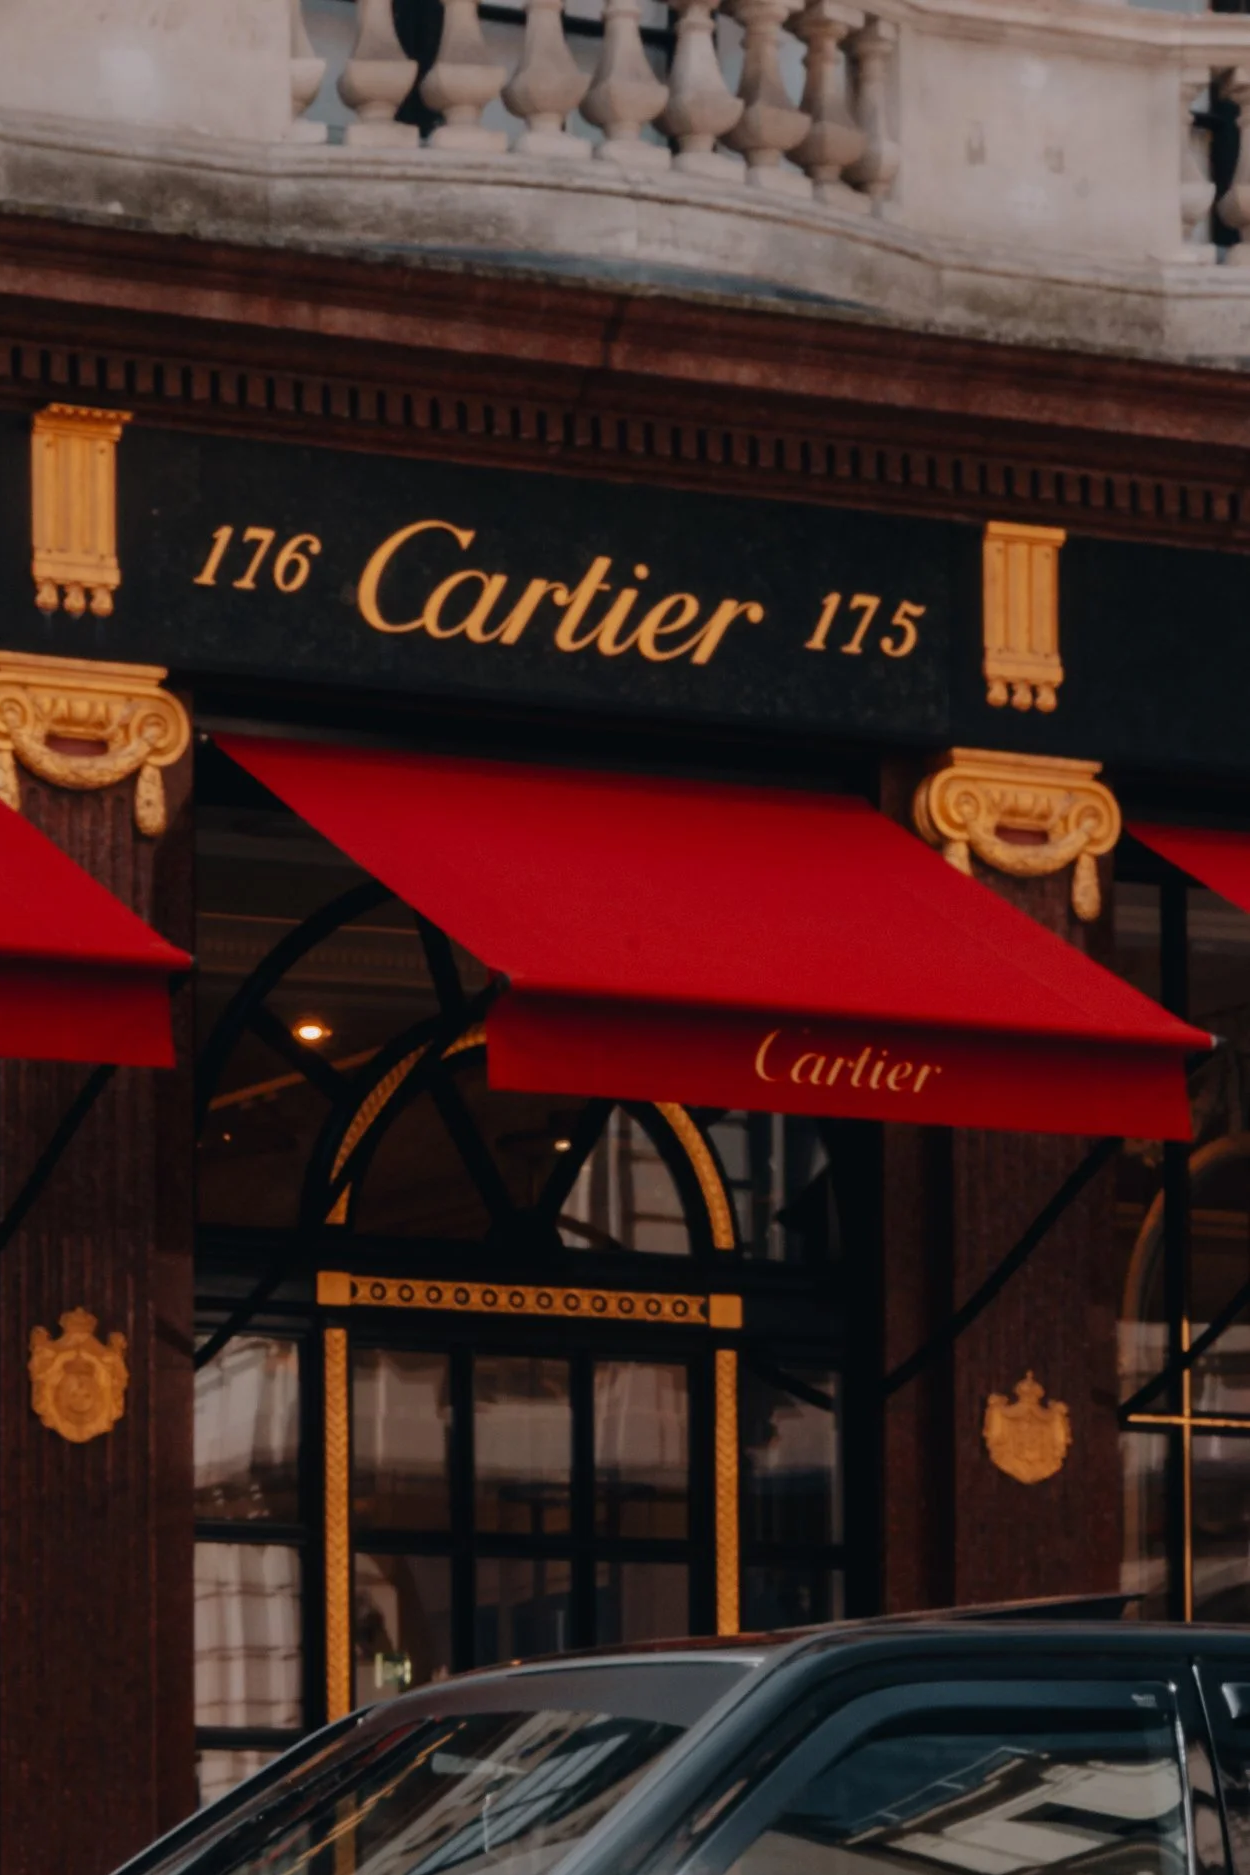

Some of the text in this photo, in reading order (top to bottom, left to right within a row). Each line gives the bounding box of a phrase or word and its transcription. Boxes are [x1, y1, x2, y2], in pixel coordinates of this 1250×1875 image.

[193, 519, 926, 665] 176 Cartier 175
[754, 1029, 942, 1094] Cartier
